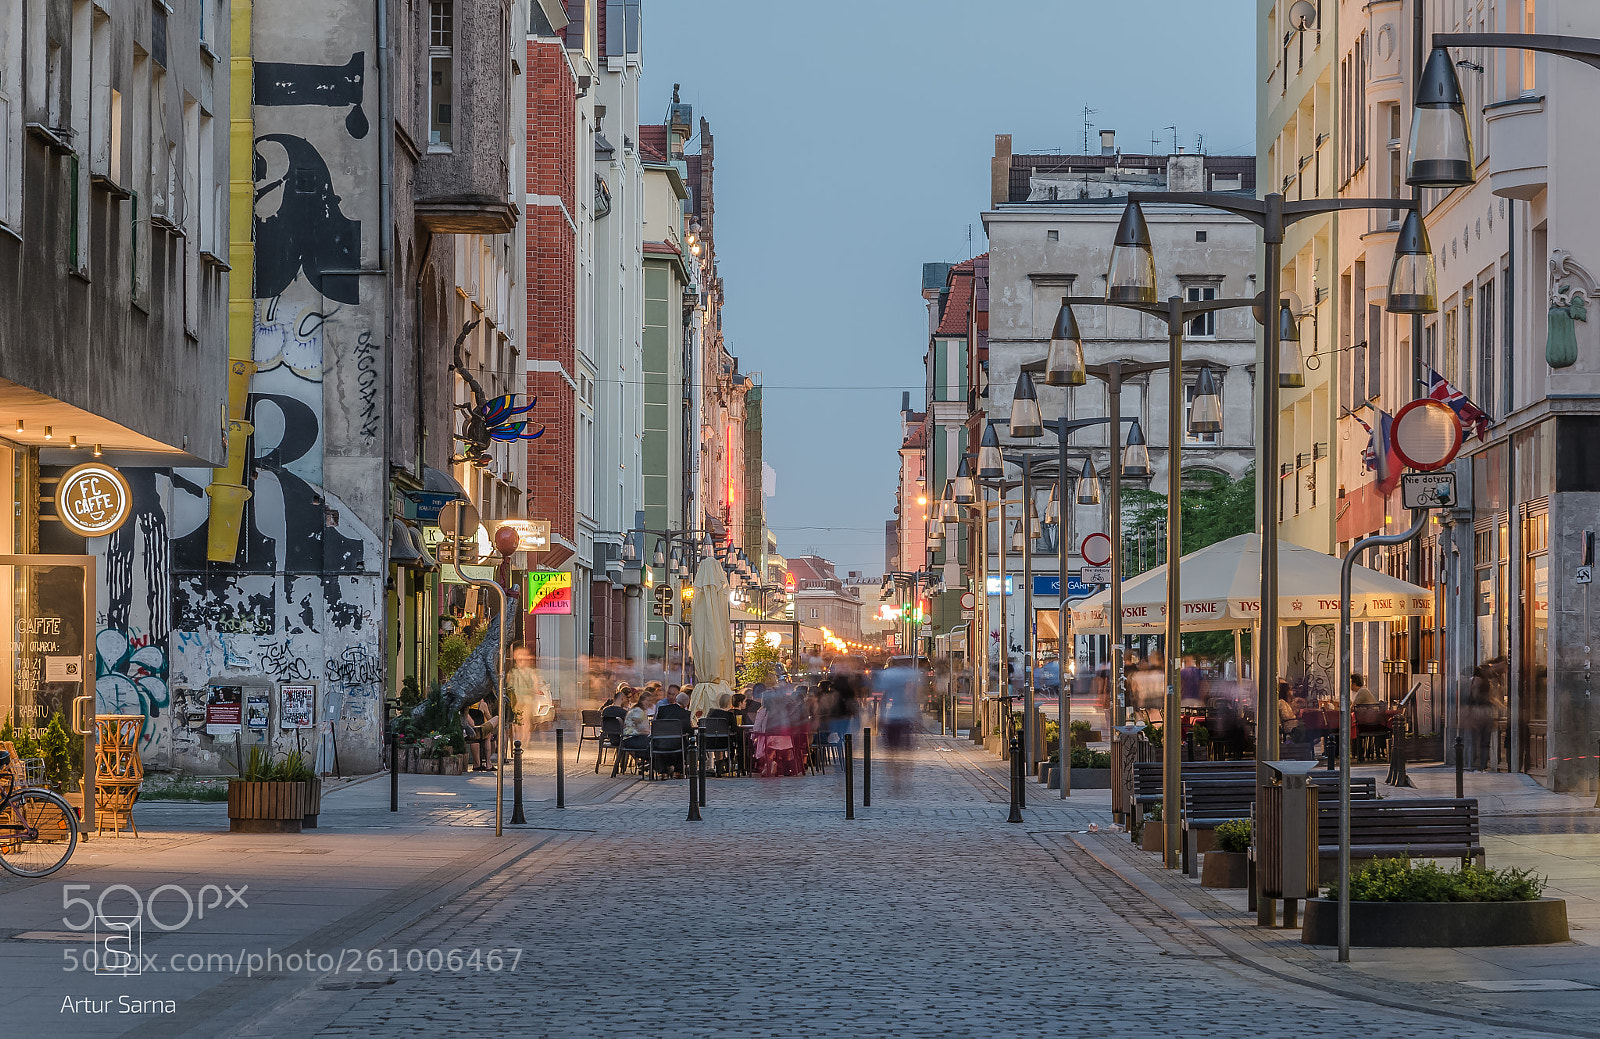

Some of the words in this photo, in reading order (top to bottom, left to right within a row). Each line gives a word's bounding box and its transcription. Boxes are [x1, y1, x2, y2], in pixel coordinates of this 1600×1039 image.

[79, 477, 102, 498] FC
[1422, 476, 1453, 485] dotyczy
[75, 493, 114, 515] CAFFE
[533, 573, 567, 582] OPTYK
[531, 600, 569, 608] DANILUK
[1121, 606, 1148, 618] YSKIE
[1183, 602, 1217, 614] TYSKIE
[1372, 598, 1393, 610] TYSKIE
[1411, 598, 1431, 609] TYSKIE
[16, 617, 61, 635] CAFFE
[19, 704, 49, 719] RABATU
